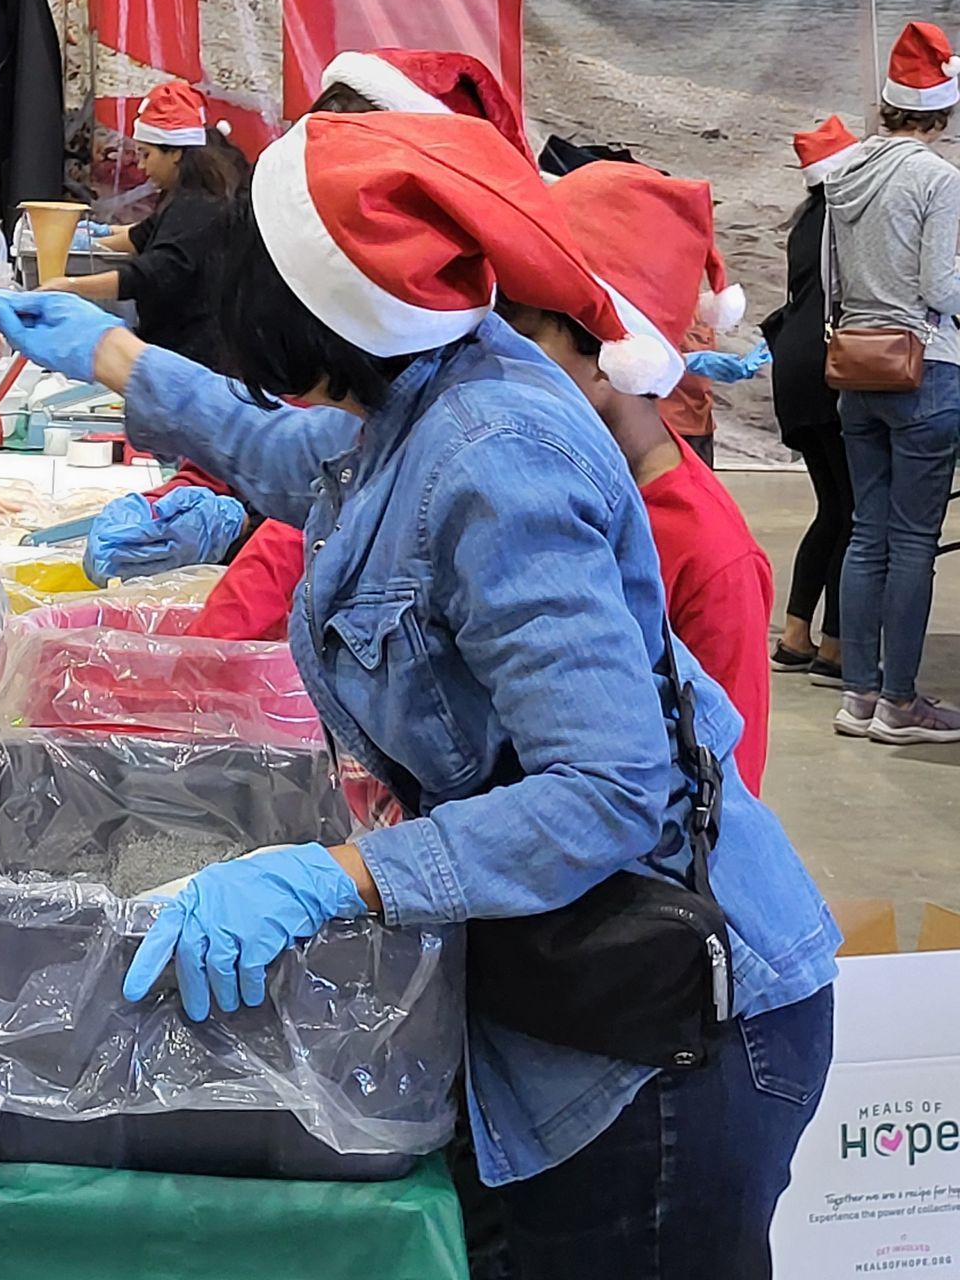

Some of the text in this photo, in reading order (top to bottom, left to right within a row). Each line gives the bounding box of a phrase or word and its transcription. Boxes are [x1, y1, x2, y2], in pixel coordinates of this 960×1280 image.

[859, 1101, 942, 1119] MEALS OF
[841, 1120, 960, 1166] Hope
[933, 1185, 947, 1200] for
[809, 1213, 859, 1223] Experience
[861, 1210, 875, 1219] the
[877, 1208, 905, 1219] power
[906, 1205, 916, 1215] of
[876, 1244, 930, 1256] GET INVOLVED
[856, 1255, 952, 1272] MEALSOFHOPE.ORG
